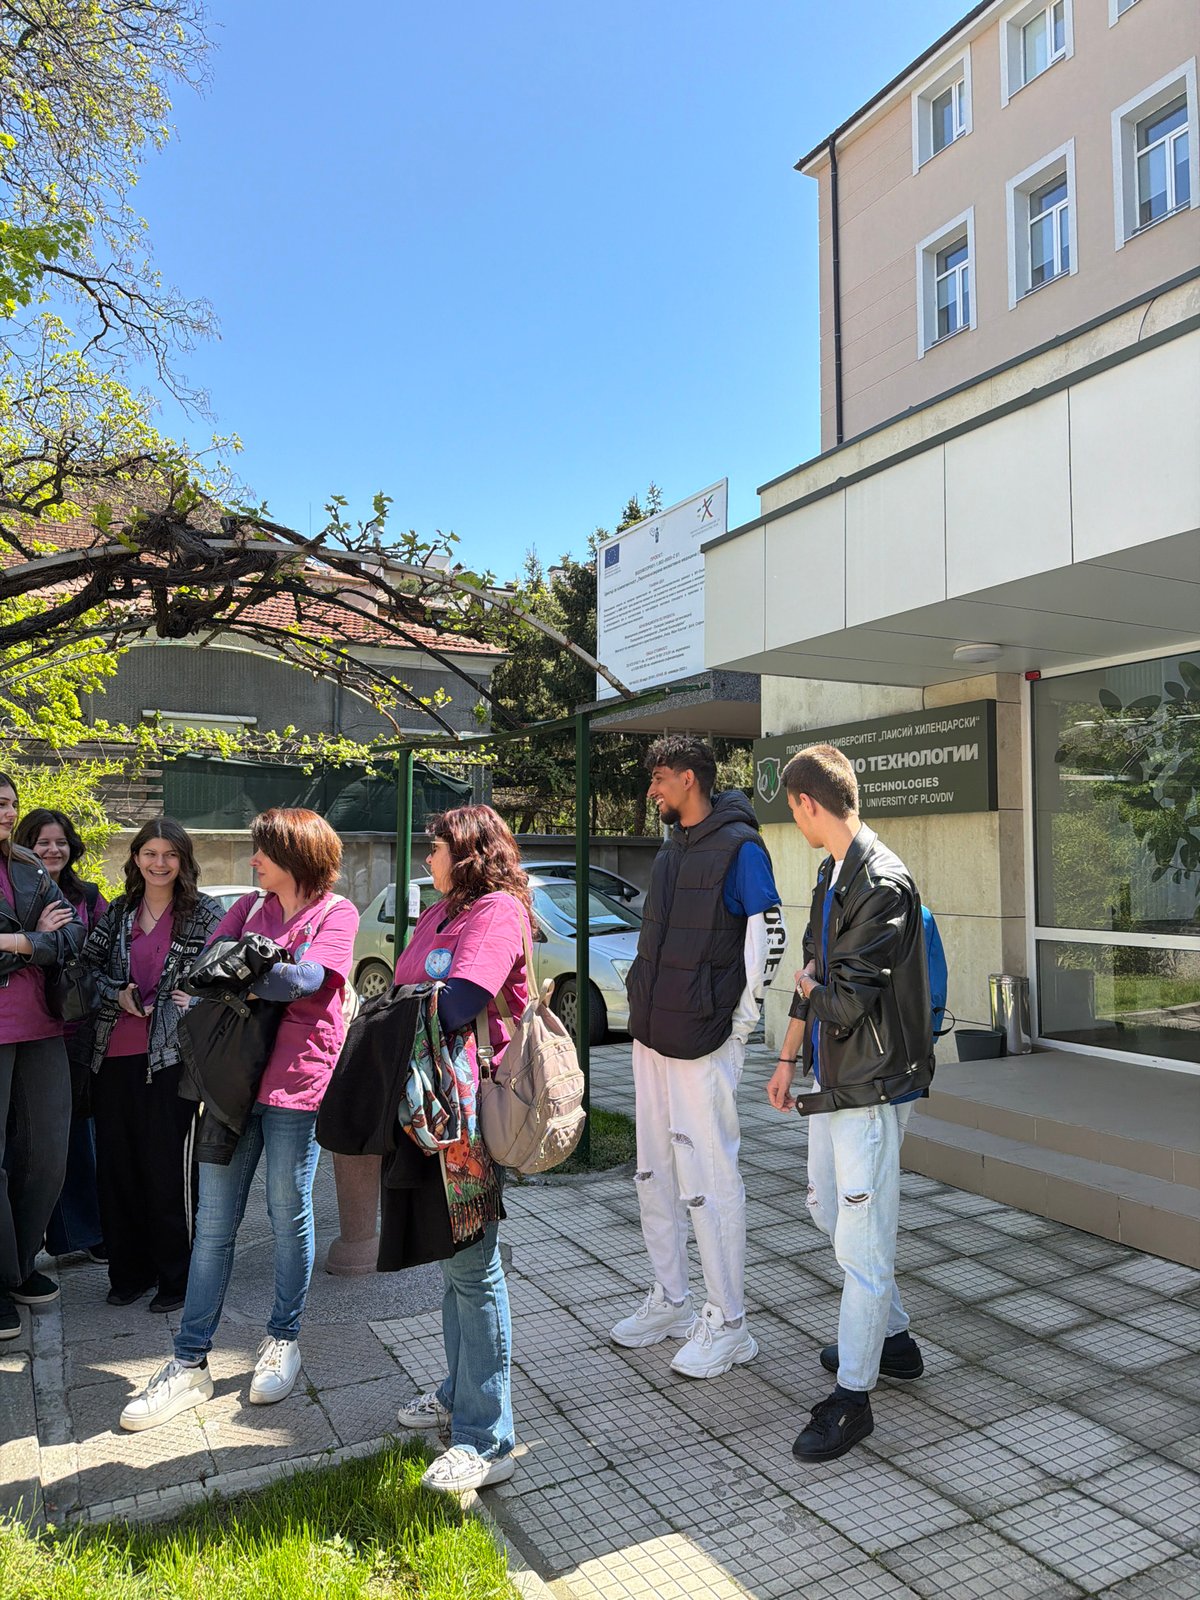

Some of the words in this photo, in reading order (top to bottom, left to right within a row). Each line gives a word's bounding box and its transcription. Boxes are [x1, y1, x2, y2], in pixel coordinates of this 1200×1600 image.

[828, 732, 877, 748] УНИВЕРСИТЕТ
[867, 743, 979, 772] ТЕХНОЛОГИИ
[863, 777, 940, 793] TECHNOLOGIES
[866, 795, 907, 808] UNIVERSITY
[908, 794, 919, 805] OF
[920, 791, 954, 804] PLOVDIV
